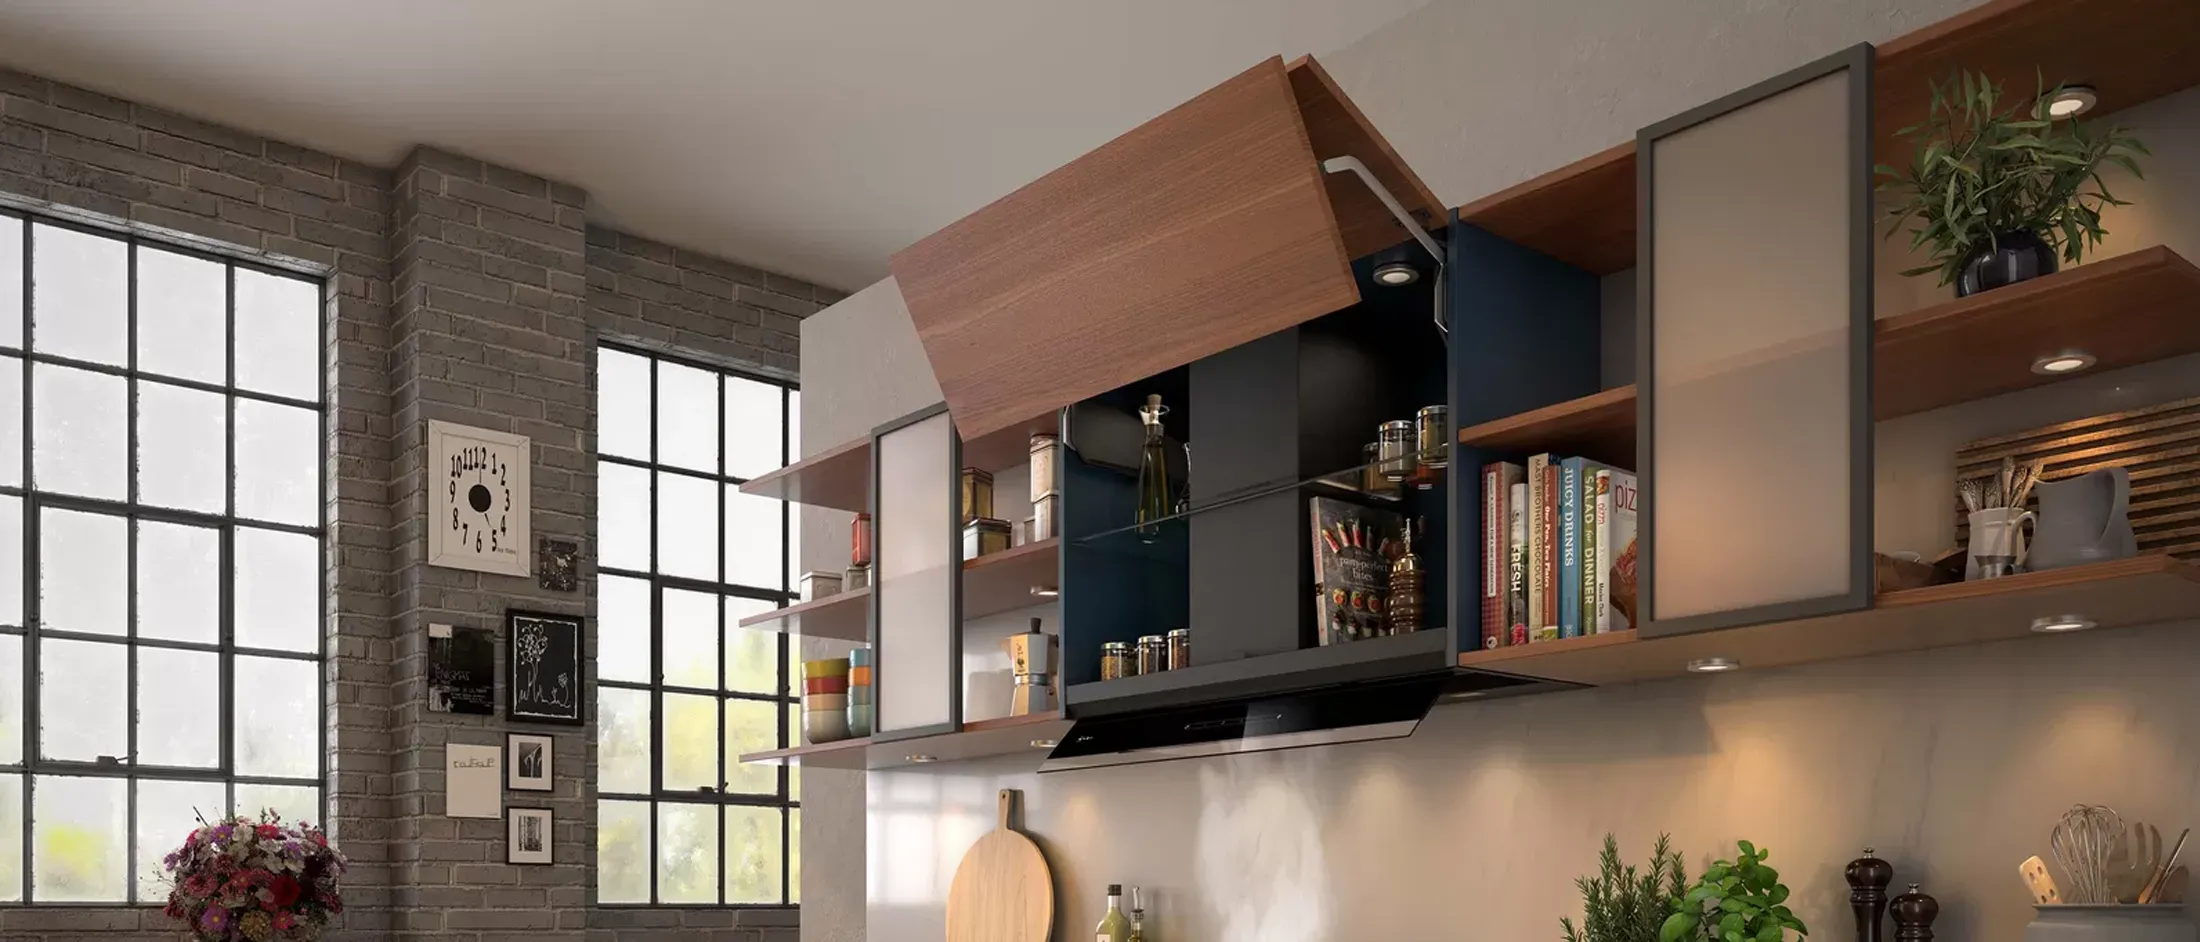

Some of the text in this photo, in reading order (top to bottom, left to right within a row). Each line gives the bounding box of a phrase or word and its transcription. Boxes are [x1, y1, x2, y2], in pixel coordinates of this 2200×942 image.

[450, 454, 462, 479] 10
[462, 447, 473, 471] 11
[474, 446, 487, 469] 12
[492, 453, 497, 475] 1
[500, 463, 505, 486] 2
[450, 480, 455, 503] 9
[505, 488, 511, 512] 3
[1584, 475, 1594, 524] SALAD
[453, 507, 458, 530] 8
[500, 515, 506, 537] 4
[1564, 467, 1574, 567] JUICY DRINKS
[462, 522, 468, 545] 7
[476, 530, 482, 553] 6
[492, 529, 497, 552] 5
[1585, 529, 1594, 543] for
[1511, 543, 1523, 592] FRESH
[1584, 547, 1595, 605] DINNER
